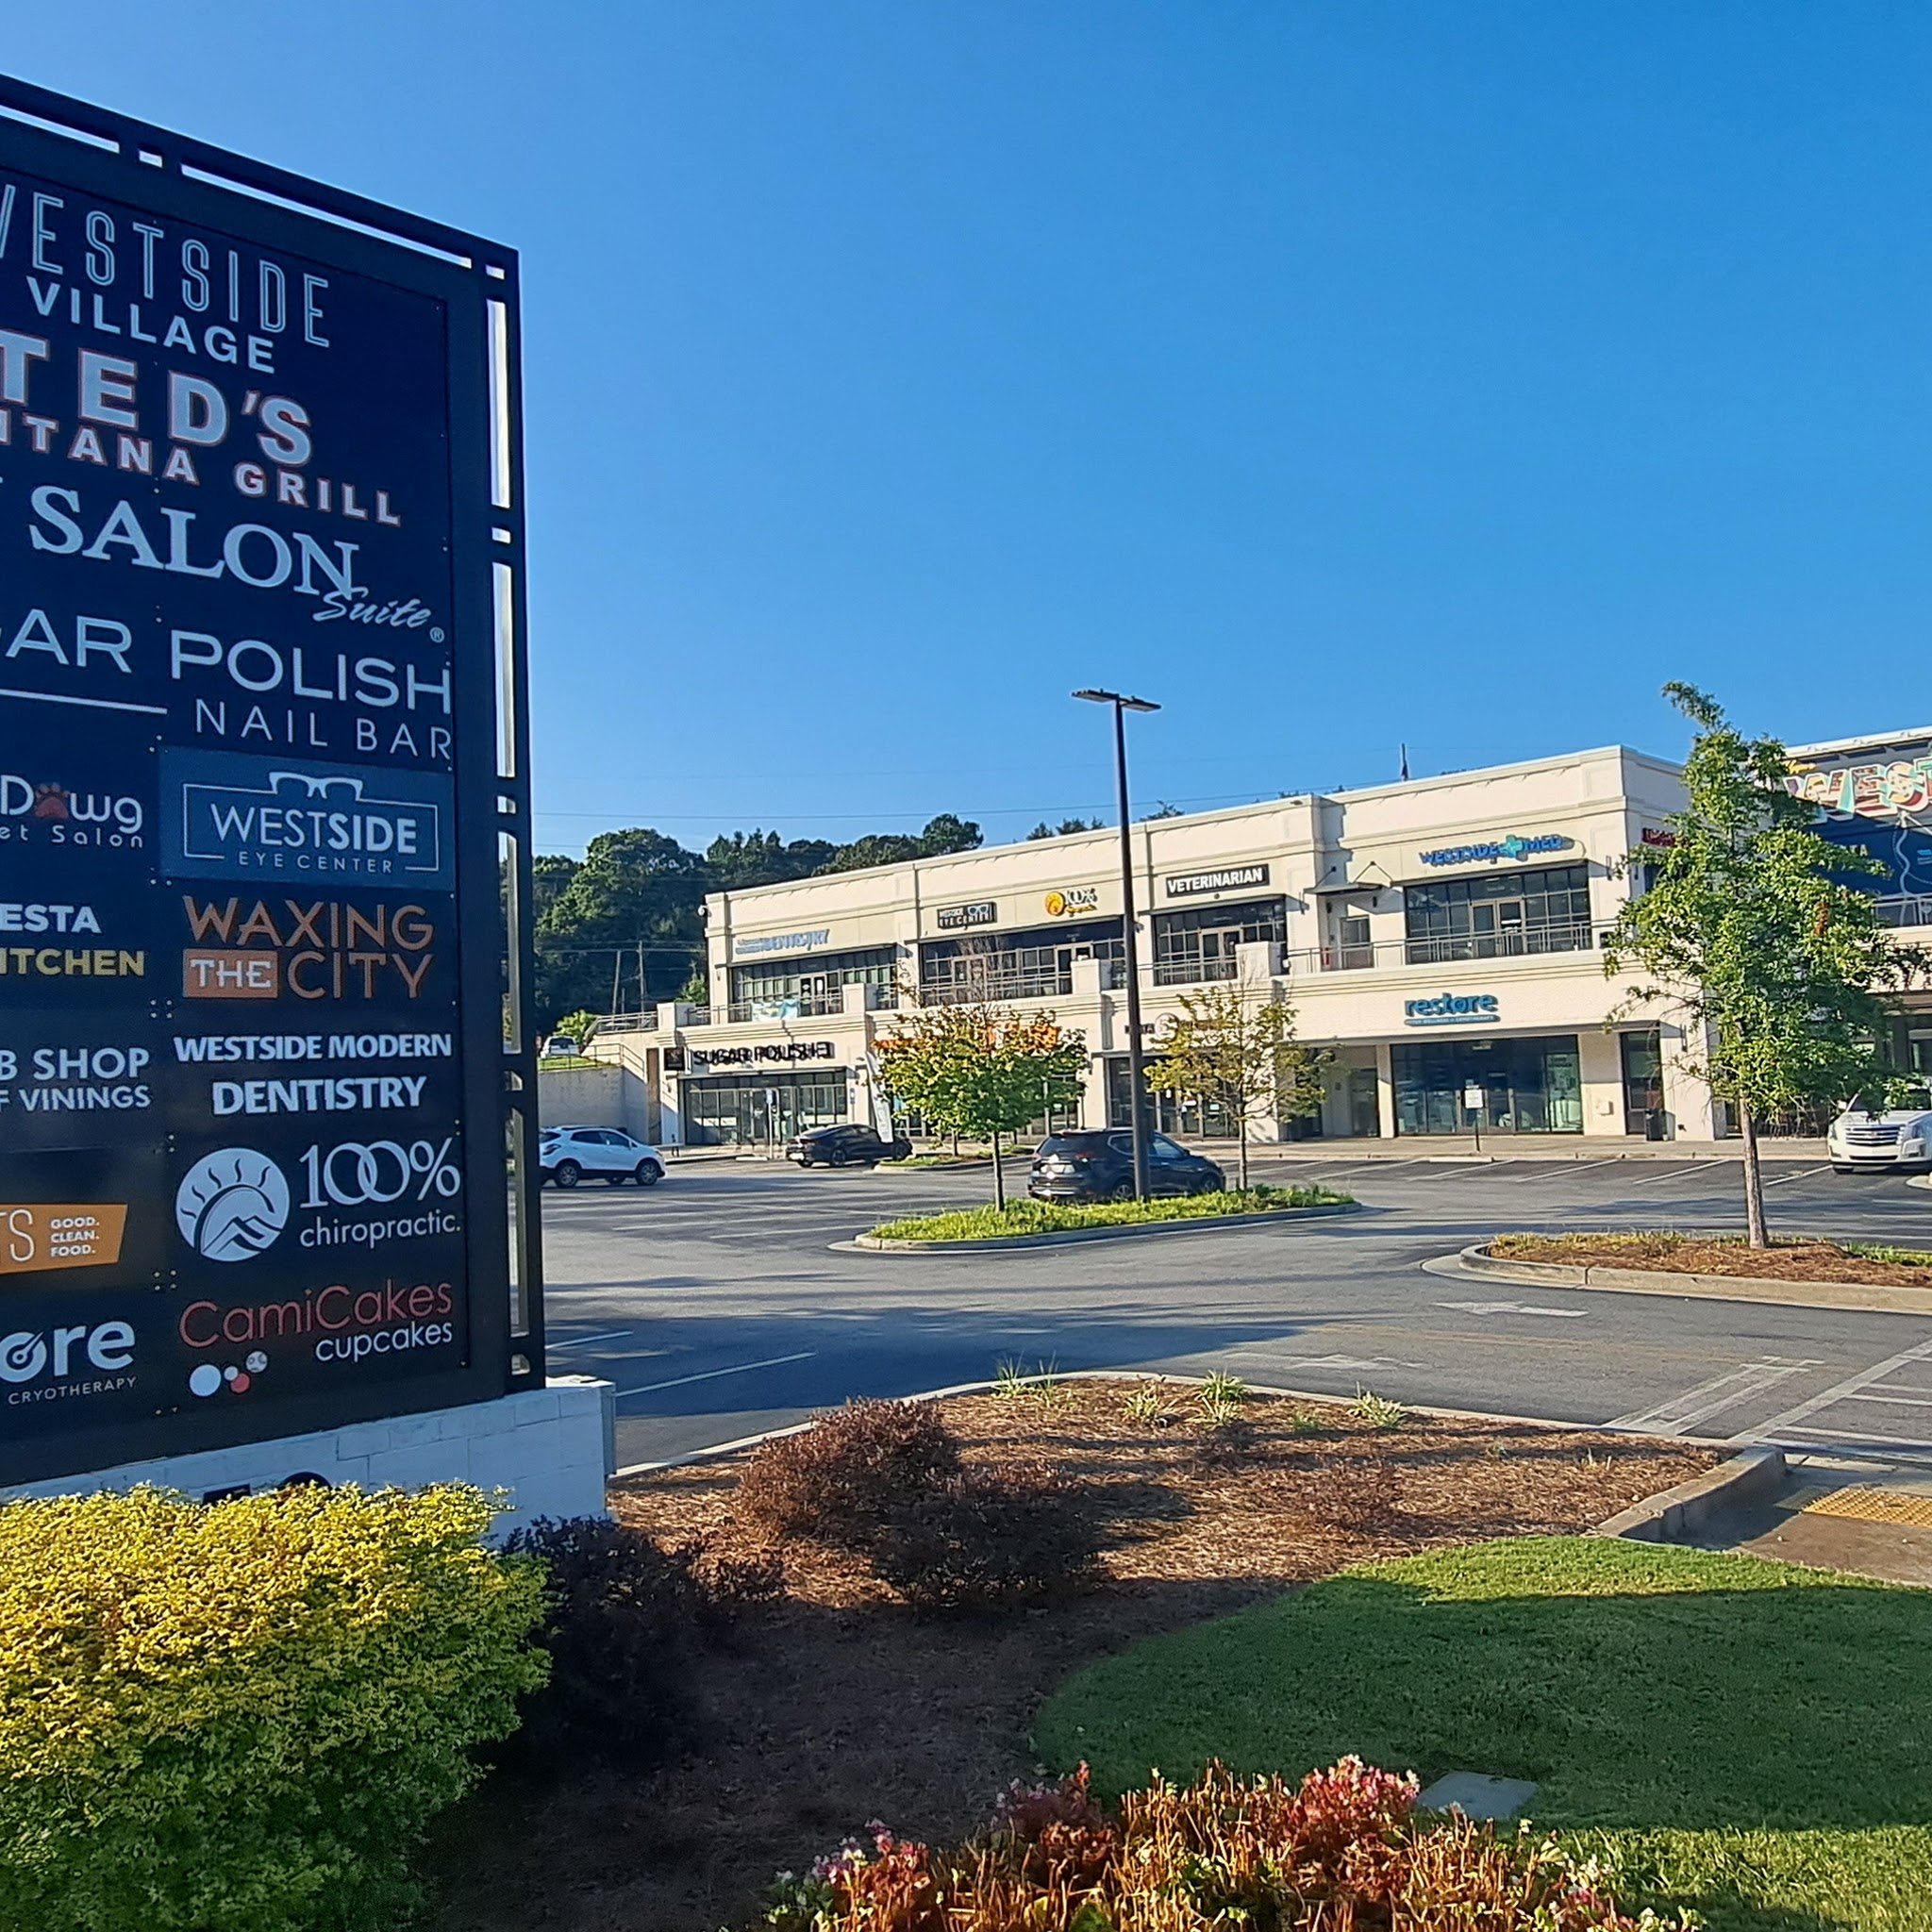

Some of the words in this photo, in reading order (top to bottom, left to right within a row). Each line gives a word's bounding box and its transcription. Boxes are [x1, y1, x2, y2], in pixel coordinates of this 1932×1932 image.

[26, 275, 275, 374] VILLAGE
[0, 329, 313, 467] TED'S
[234, 462, 401, 527] GRILL
[28, 485, 359, 600] SALON
[312, 586, 431, 628] Suite
[0, 608, 132, 674] AR
[171, 629, 451, 714] POLISH
[195, 699, 328, 747] NAIL
[357, 718, 451, 759] BAR
[51, 824, 142, 848] Salon
[210, 803, 417, 855] WESTSIDE
[239, 851, 284, 867] EYE
[296, 855, 392, 874] CENTER
[1419, 841, 1501, 867] WESTSIDE
[1524, 834, 1564, 855] MED
[1167, 867, 1263, 894] VETERINARIAN
[0, 903, 102, 934] ESTA
[183, 895, 434, 951] WAXING
[0, 947, 144, 976] ITCHEN
[190, 958, 273, 990] THE
[287, 953, 433, 999] CITY
[1404, 992, 1499, 1017] restore
[33, 1047, 150, 1081] SHOP
[174, 1036, 322, 1062] WESTSIDE
[327, 1033, 453, 1059] MODERN
[18, 1085, 151, 1112] VININGS
[212, 1075, 427, 1116] DENTISTRY
[298, 1137, 460, 1209] 100%
[50, 1216, 100, 1229] GOOD.
[50, 1230, 100, 1243] CLEAN.
[299, 1208, 461, 1249] chiropractic.
[50, 1244, 96, 1257] FOOD.
[179, 1278, 452, 1348] CamiCakes
[315, 1320, 453, 1362] cupcakes
[8, 1375, 137, 1406] CRYOTHERAPY
